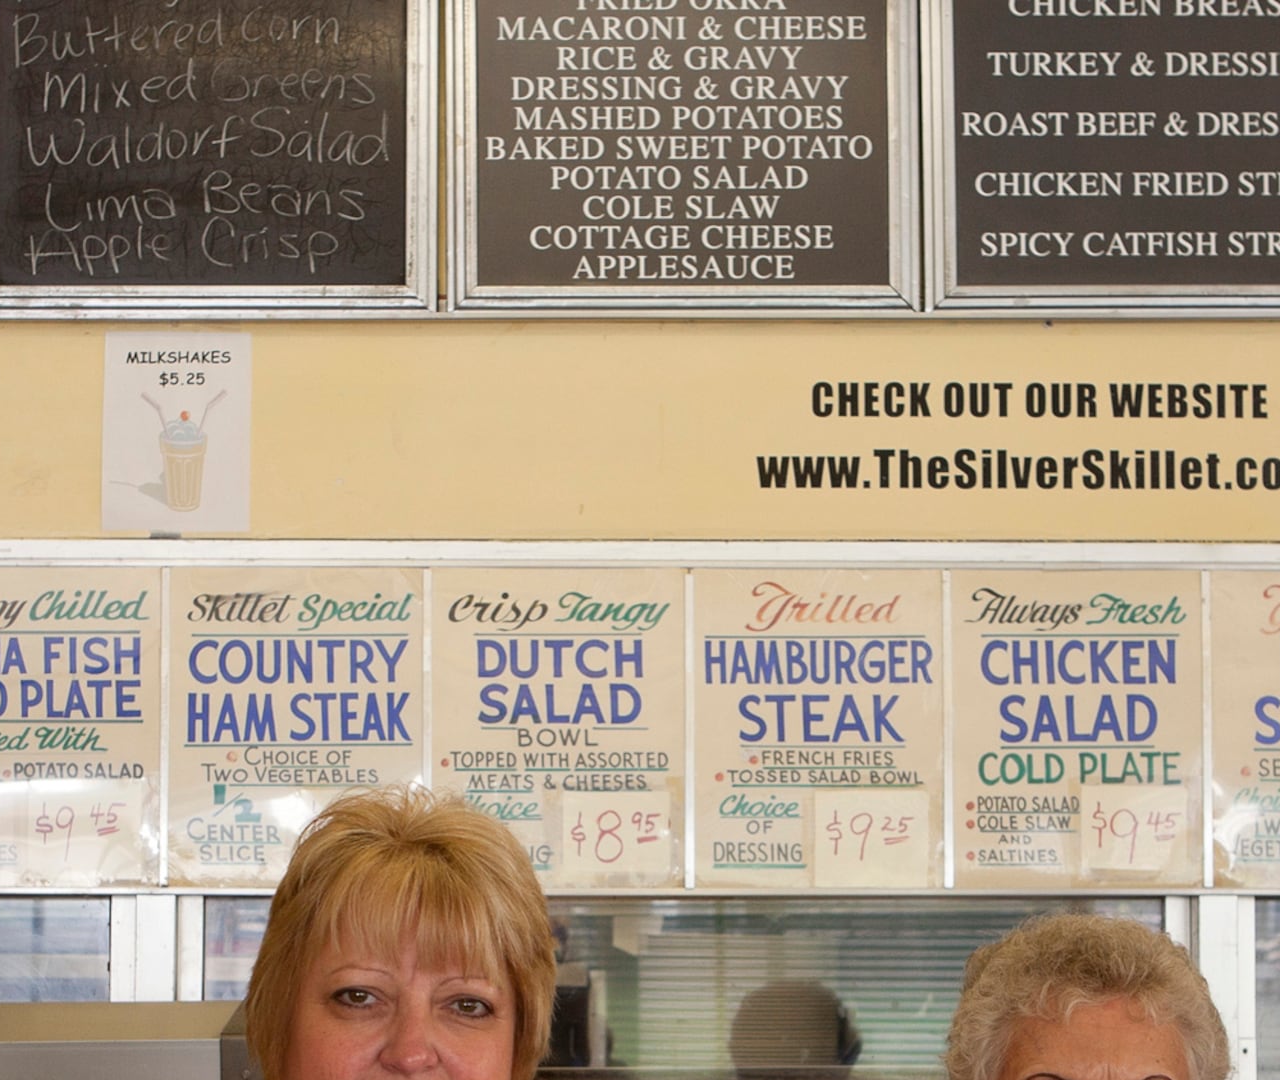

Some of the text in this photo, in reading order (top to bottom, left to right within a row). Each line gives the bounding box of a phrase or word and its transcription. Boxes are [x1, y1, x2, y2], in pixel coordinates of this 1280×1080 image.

[498, 16, 866, 40] MACARONI & CHEESE
[987, 52, 1121, 76] TURKEY
[1131, 52, 1155, 76] &
[514, 105, 842, 130] MASHED POTATOES
[486, 135, 872, 160] BAKED SWEET POTATO
[203, 170, 365, 220] Beans
[975, 172, 1122, 196] CHICKEN
[1133, 172, 1228, 196] FRIED
[24, 216, 338, 276] Apple Crisp
[981, 232, 1074, 256] SPICY
[1083, 232, 1218, 256] CATFISH
[573, 255, 794, 279] APPLESAUCE
[126, 351, 231, 364] MILKSHAKES
[160, 372, 205, 387] $5.25
[813, 382, 1267, 418] CHECK OUT OUR WEBSITE
[187, 593, 413, 631] Skillet Special
[967, 588, 1186, 631] Always Fresh
[44, 637, 140, 675] FISH
[189, 640, 408, 684] COUNTRY
[477, 640, 643, 679] DUTCH
[705, 640, 932, 684] HAMBURGER
[981, 639, 1176, 685] CHICKEN
[20, 680, 141, 718] PLATE
[478, 683, 641, 724] SALAD
[188, 692, 411, 742] HAM STEAK
[739, 695, 904, 742] STEAK
[1000, 694, 1157, 743] SALAD
[517, 727, 599, 747] BOWL
[14, 762, 78, 778] POTATO
[84, 762, 144, 779] SALAD
[450, 751, 669, 772] TOPPED WITH ASSORTED
[762, 751, 896, 766] FRENCH FRIES
[978, 752, 1181, 786] COLD PLATE
[727, 767, 923, 787] TOSSED SALAD BOWL
[978, 849, 1057, 866] SALTINES
